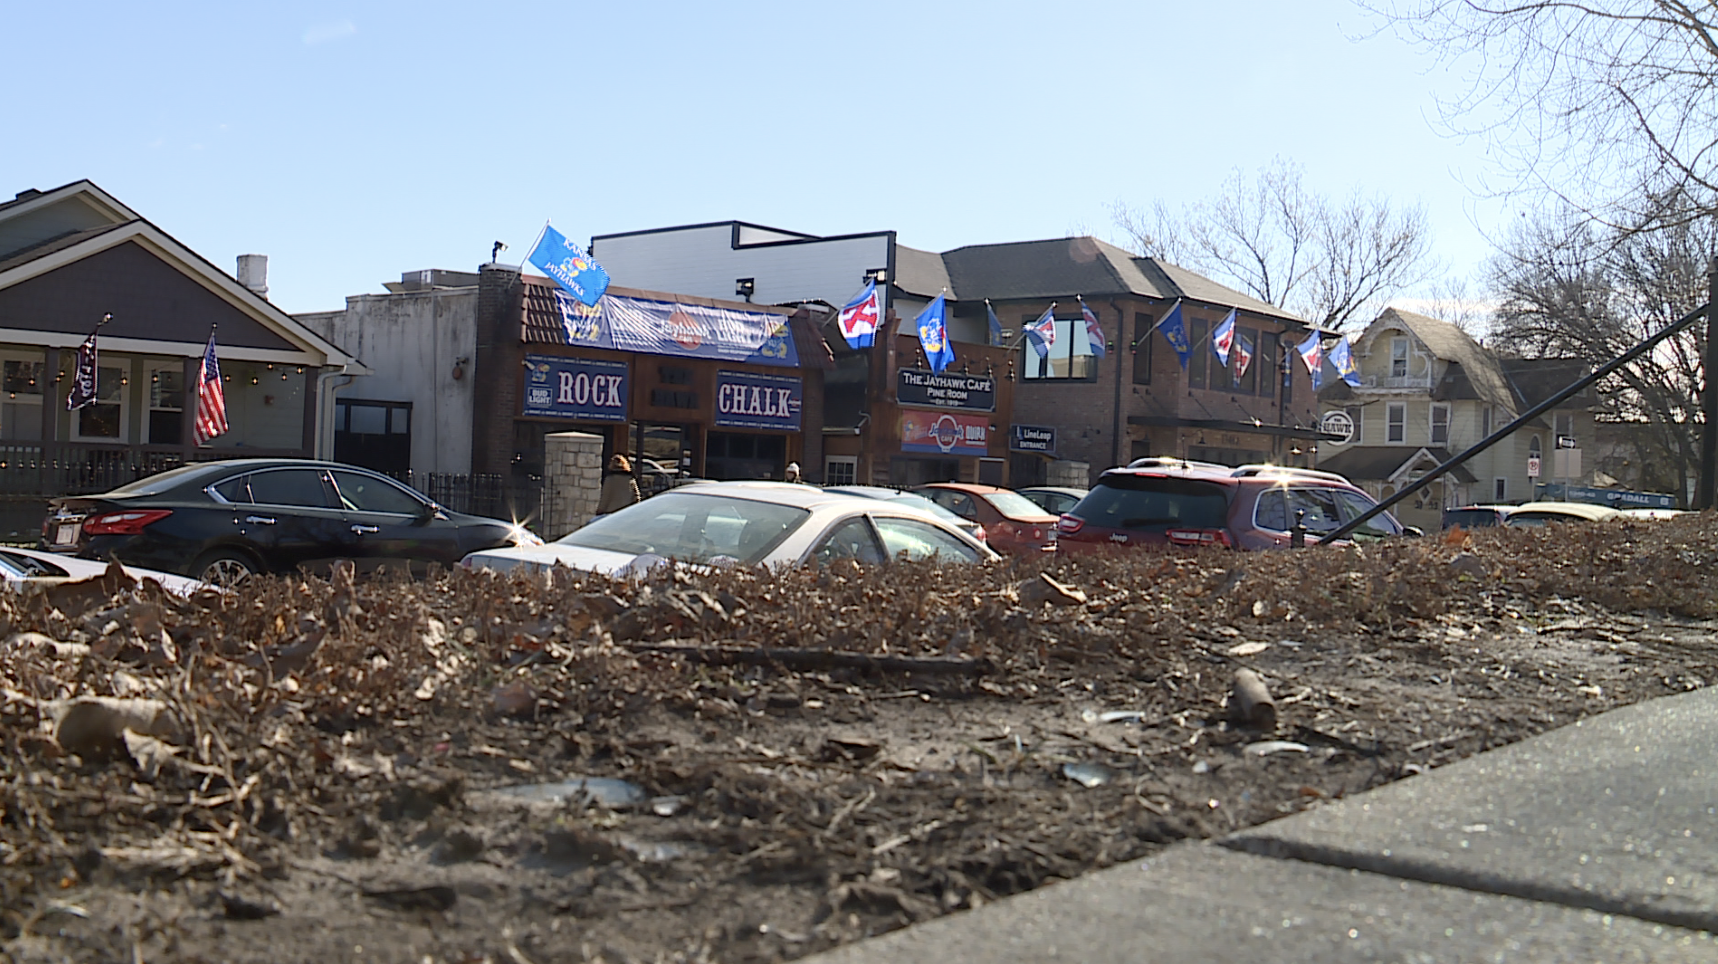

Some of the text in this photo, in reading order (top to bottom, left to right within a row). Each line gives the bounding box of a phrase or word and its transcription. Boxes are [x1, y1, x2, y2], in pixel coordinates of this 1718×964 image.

[563, 238, 597, 272] KANSAS
[544, 261, 585, 296] JAYHAWKS
[903, 372, 923, 385] THE
[923, 374, 967, 390] JAYHAWK
[531, 389, 548, 397] BUD
[556, 371, 623, 408] ROCK
[927, 387, 968, 400] PINE ROOM
[528, 395, 551, 405] LIGHT
[717, 383, 792, 418] CHALK
[1323, 422, 1352, 434] HAWK
[1023, 429, 1052, 442] LineLeap
[1019, 440, 1047, 450] ENTRANCE
[1109, 532, 1128, 543] Jeep
